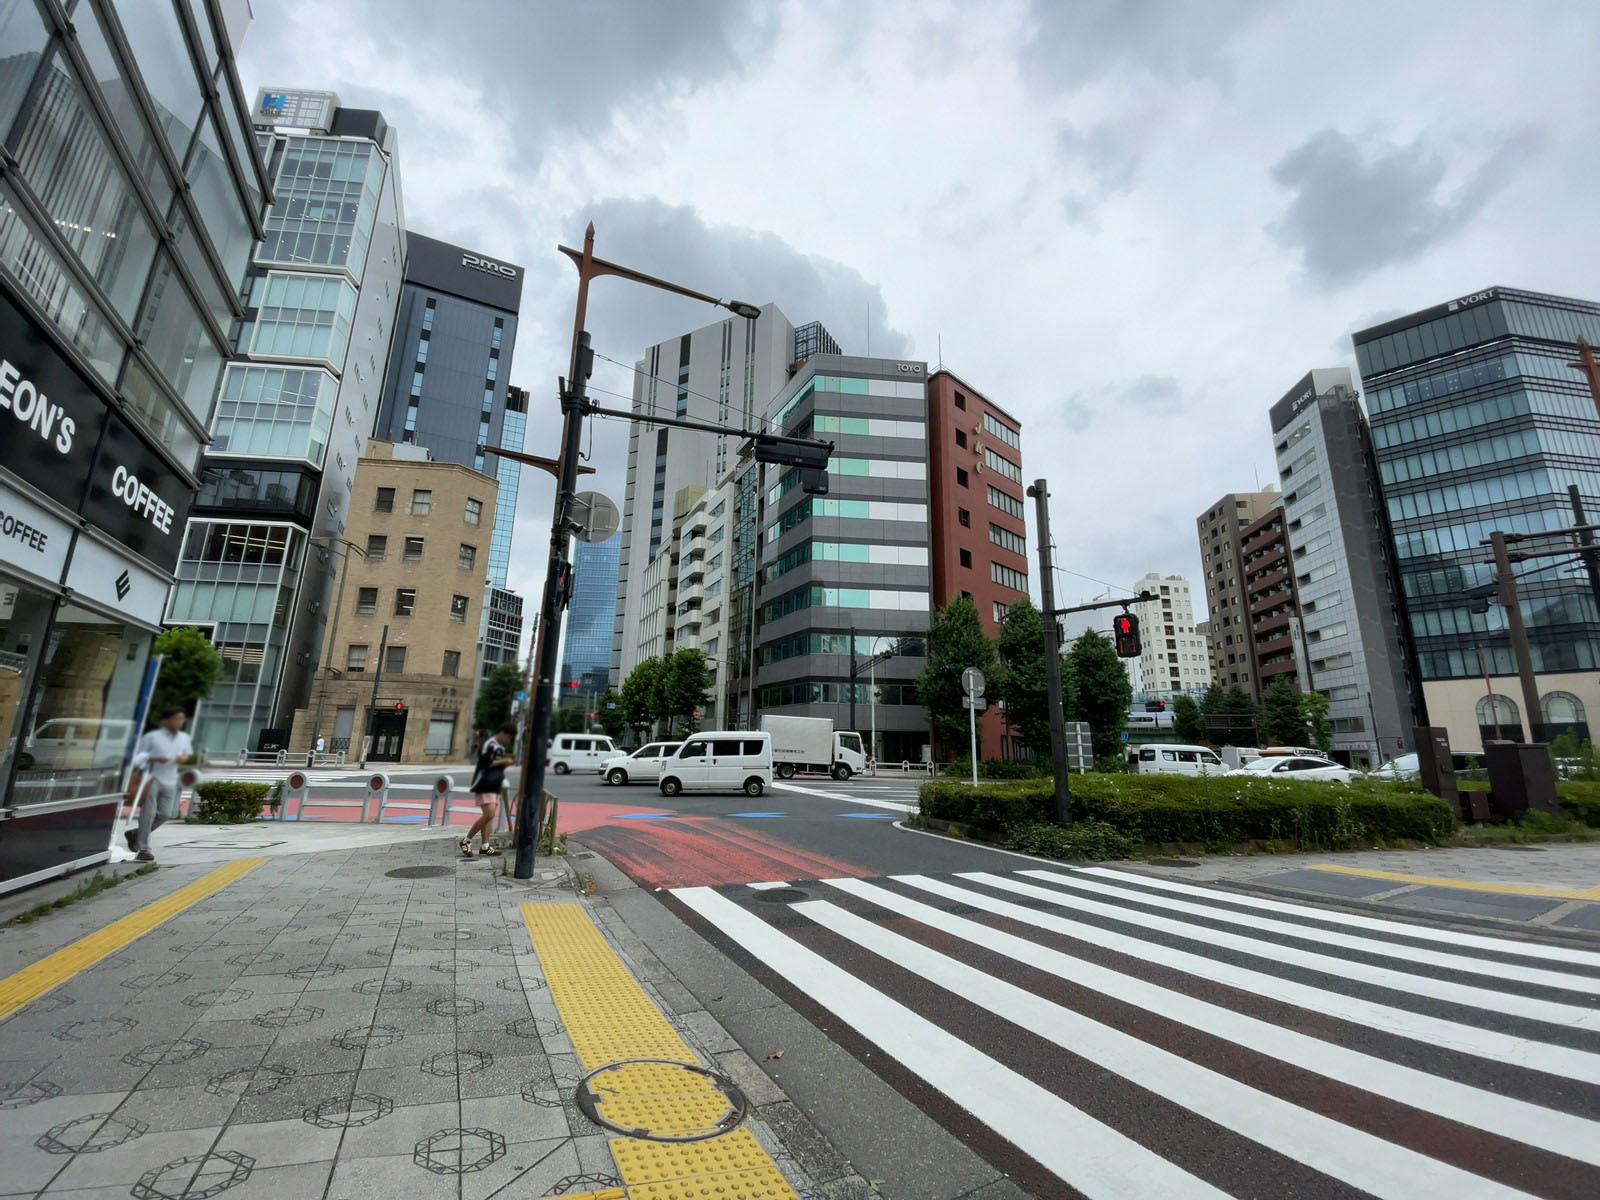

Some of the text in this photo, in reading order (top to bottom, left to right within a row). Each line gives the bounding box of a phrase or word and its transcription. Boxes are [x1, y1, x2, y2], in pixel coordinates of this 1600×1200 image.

[1460, 289, 1494, 305] VORT
[896, 363, 921, 373] TOYO
[112, 465, 175, 535] COFFEE
